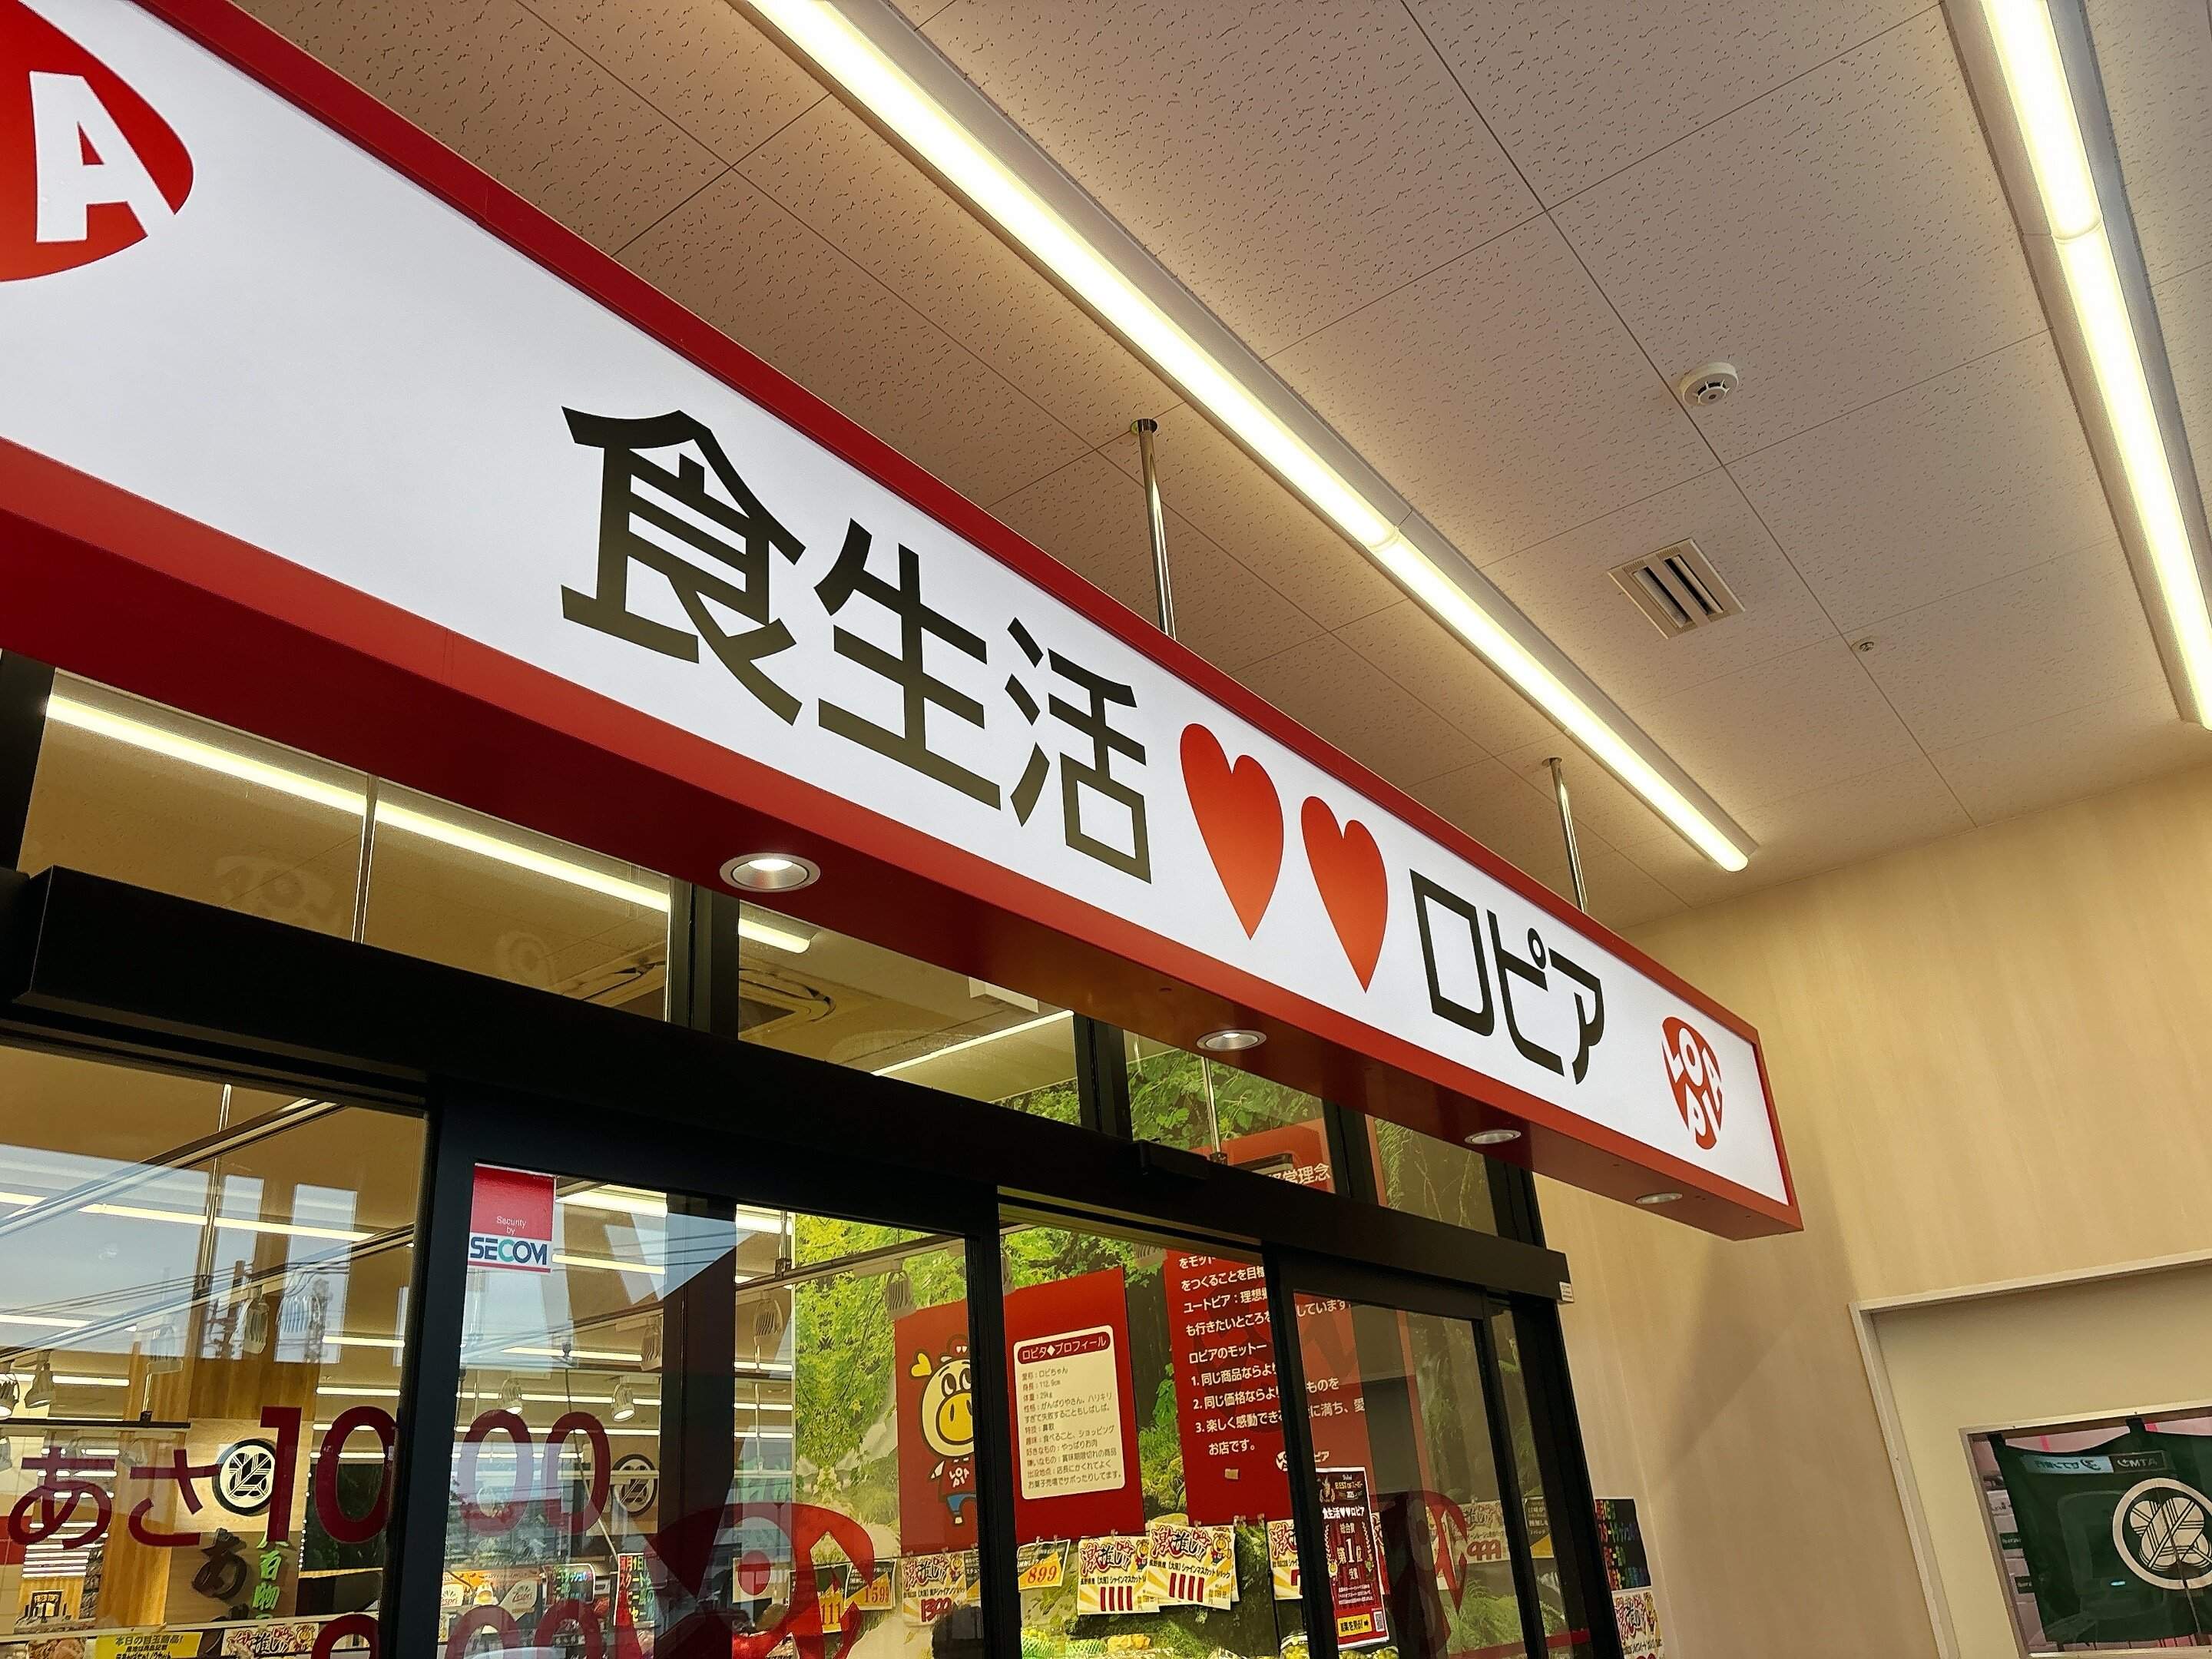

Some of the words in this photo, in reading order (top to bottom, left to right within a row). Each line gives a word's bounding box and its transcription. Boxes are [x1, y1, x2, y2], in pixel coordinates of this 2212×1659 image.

[561, 406, 1152, 885] 食生活
[1409, 868, 1604, 1084] ロピア
[496, 1216, 526, 1229] Security
[506, 1227, 515, 1235] by
[470, 1237, 548, 1266] SECOM
[1307, 1397, 1366, 1419] に満ち、愛
[1027, 1565, 1058, 1584] 899
[1100, 1586, 1132, 1611] 1111
[1168, 1573, 1204, 1602] 1111
[441, 1598, 458, 1606] espri
